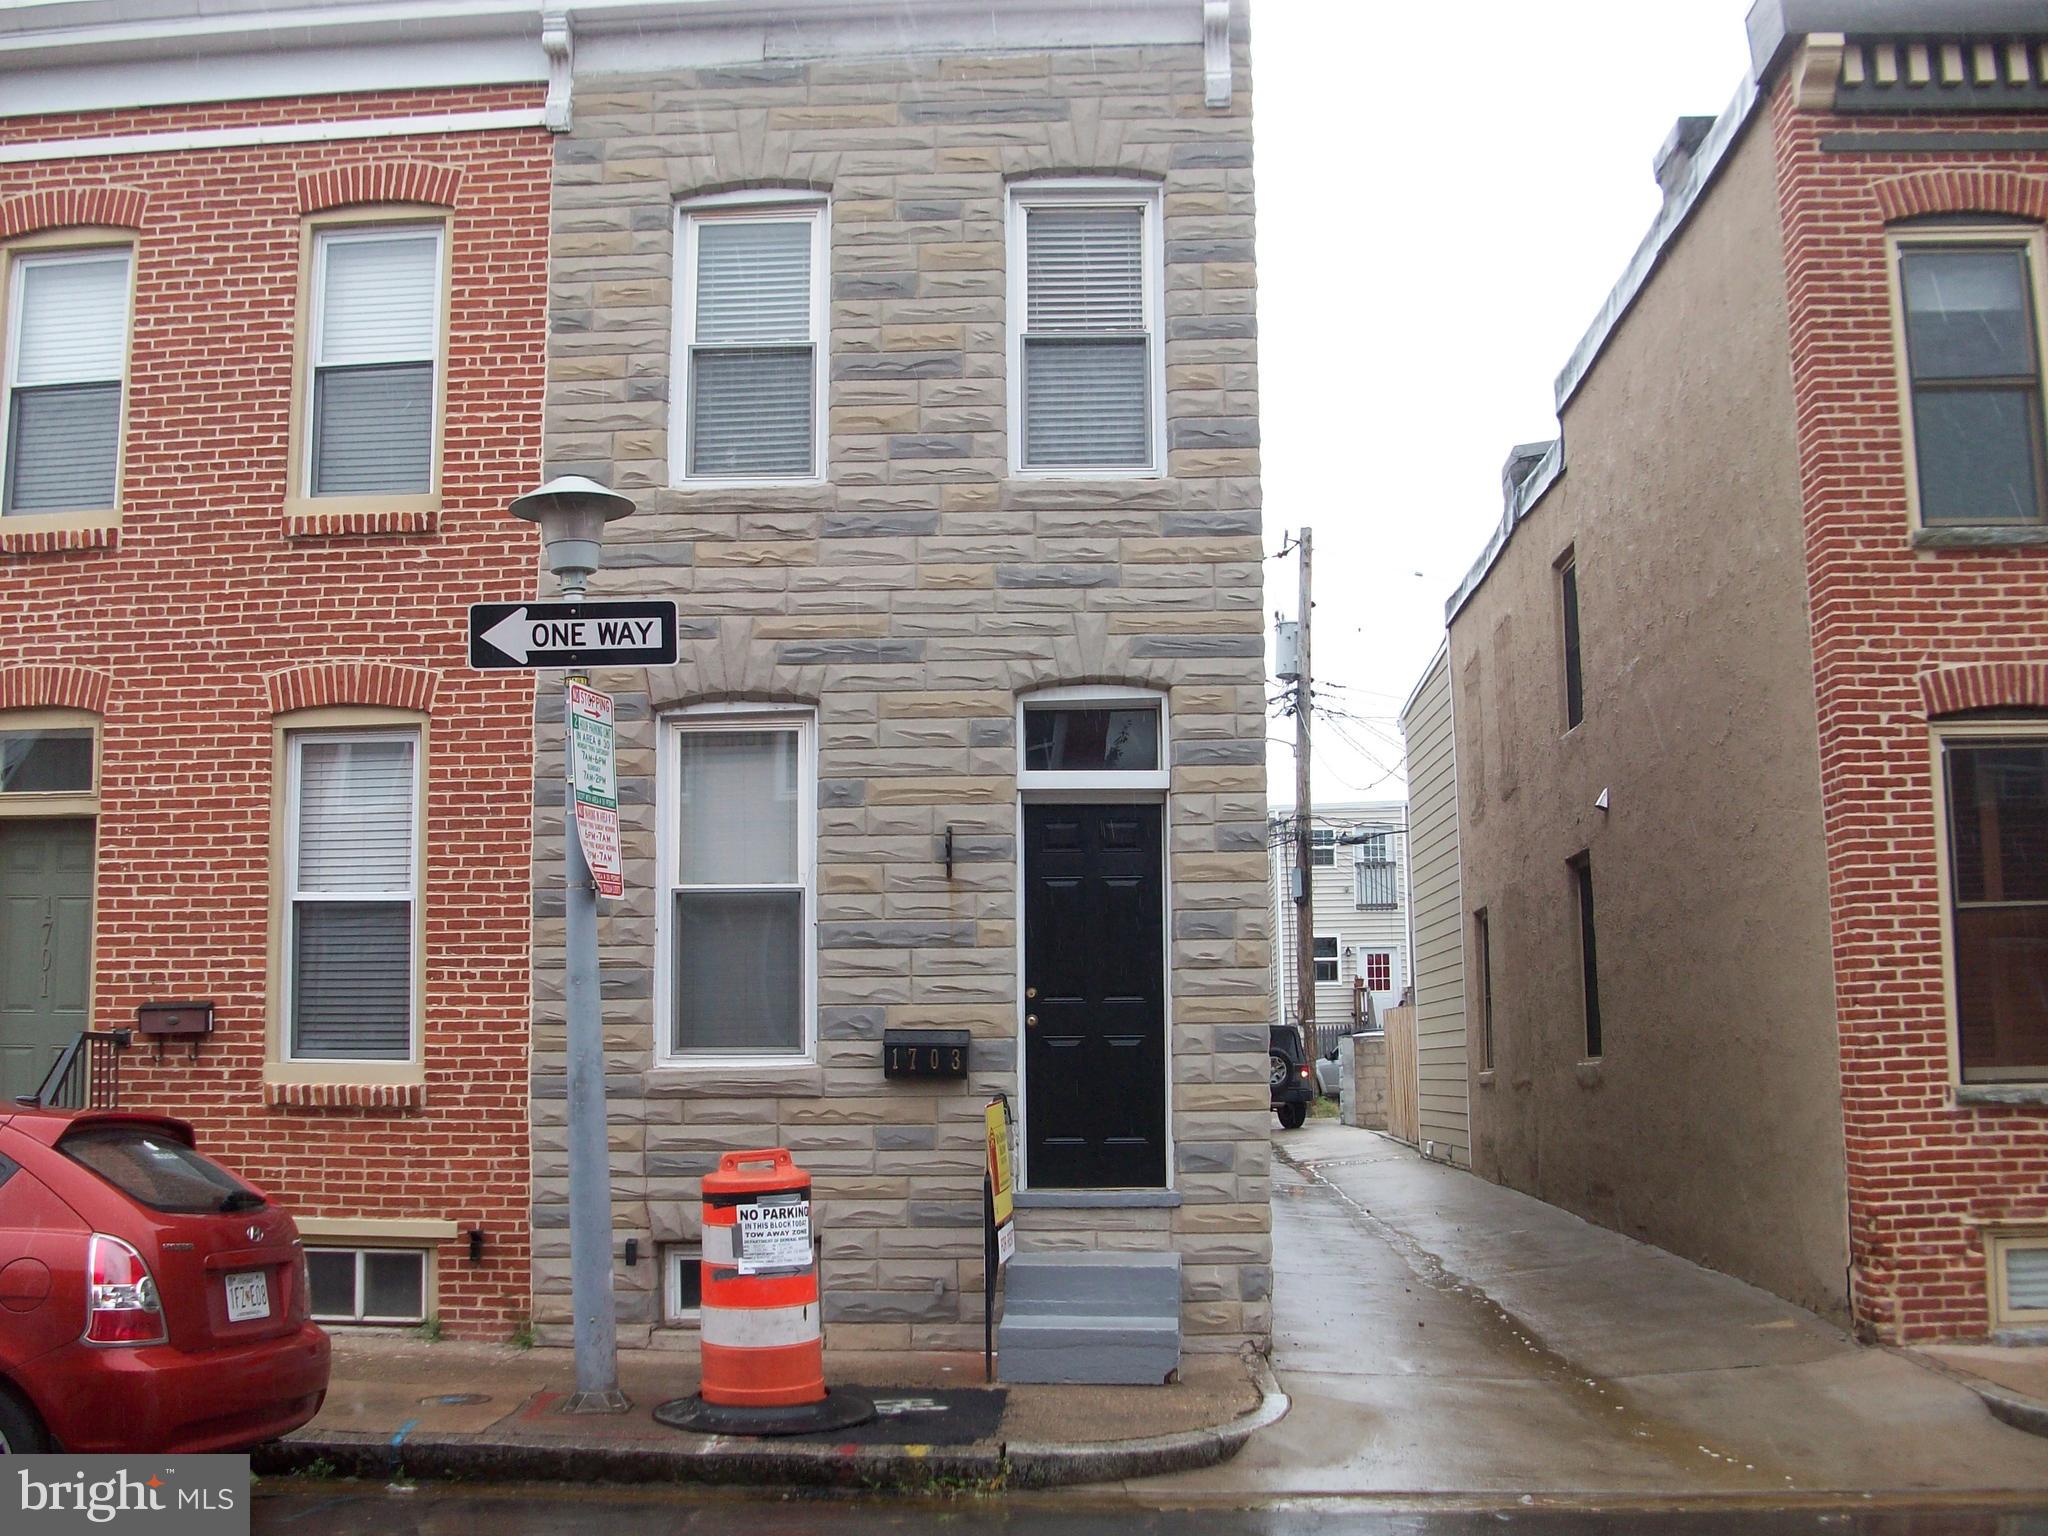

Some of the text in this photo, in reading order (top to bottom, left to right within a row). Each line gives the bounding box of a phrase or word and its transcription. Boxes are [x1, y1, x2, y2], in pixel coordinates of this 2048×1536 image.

[532, 621, 654, 648] ONE WAY
[581, 691, 609, 712] STOPPING
[574, 715, 579, 727] 2
[582, 733, 596, 745] AREA
[41, 896, 54, 998] 1701
[892, 1047, 961, 1070] 1703
[740, 1209, 758, 1220] NO
